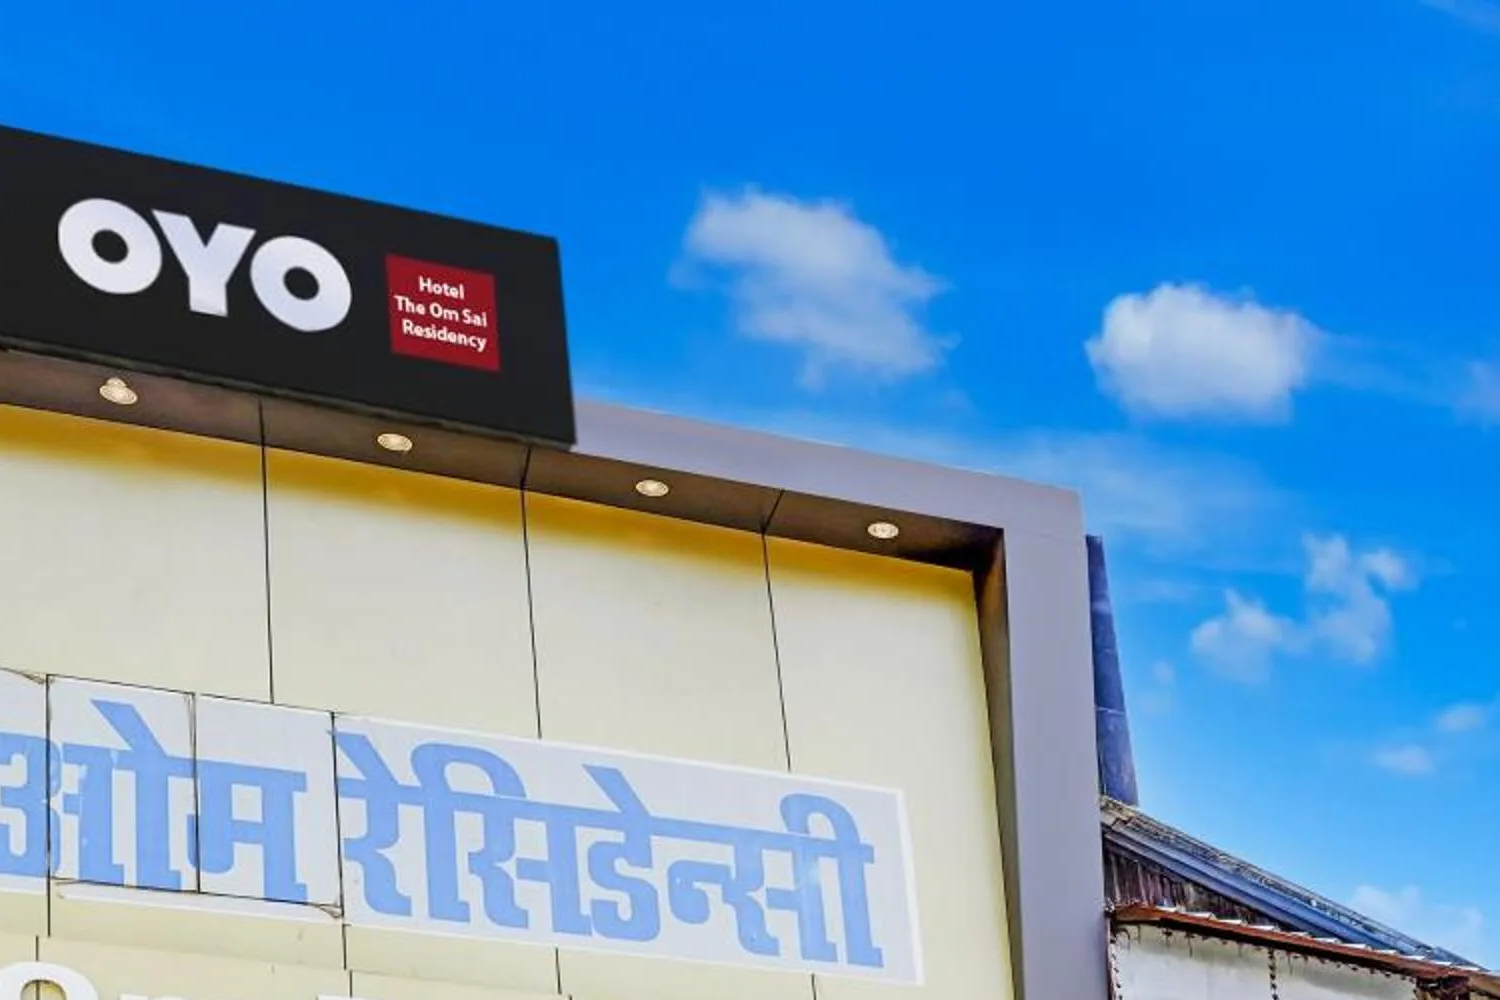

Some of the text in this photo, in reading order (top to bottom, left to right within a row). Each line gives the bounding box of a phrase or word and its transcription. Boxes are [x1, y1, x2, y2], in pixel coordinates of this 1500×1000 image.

[58, 198, 351, 331] OYO
[418, 275, 464, 299] Hotel
[394, 295, 488, 327] The Om Sai
[402, 319, 488, 352] Residency
[328, 730, 884, 970] रेसिडेन्सी
